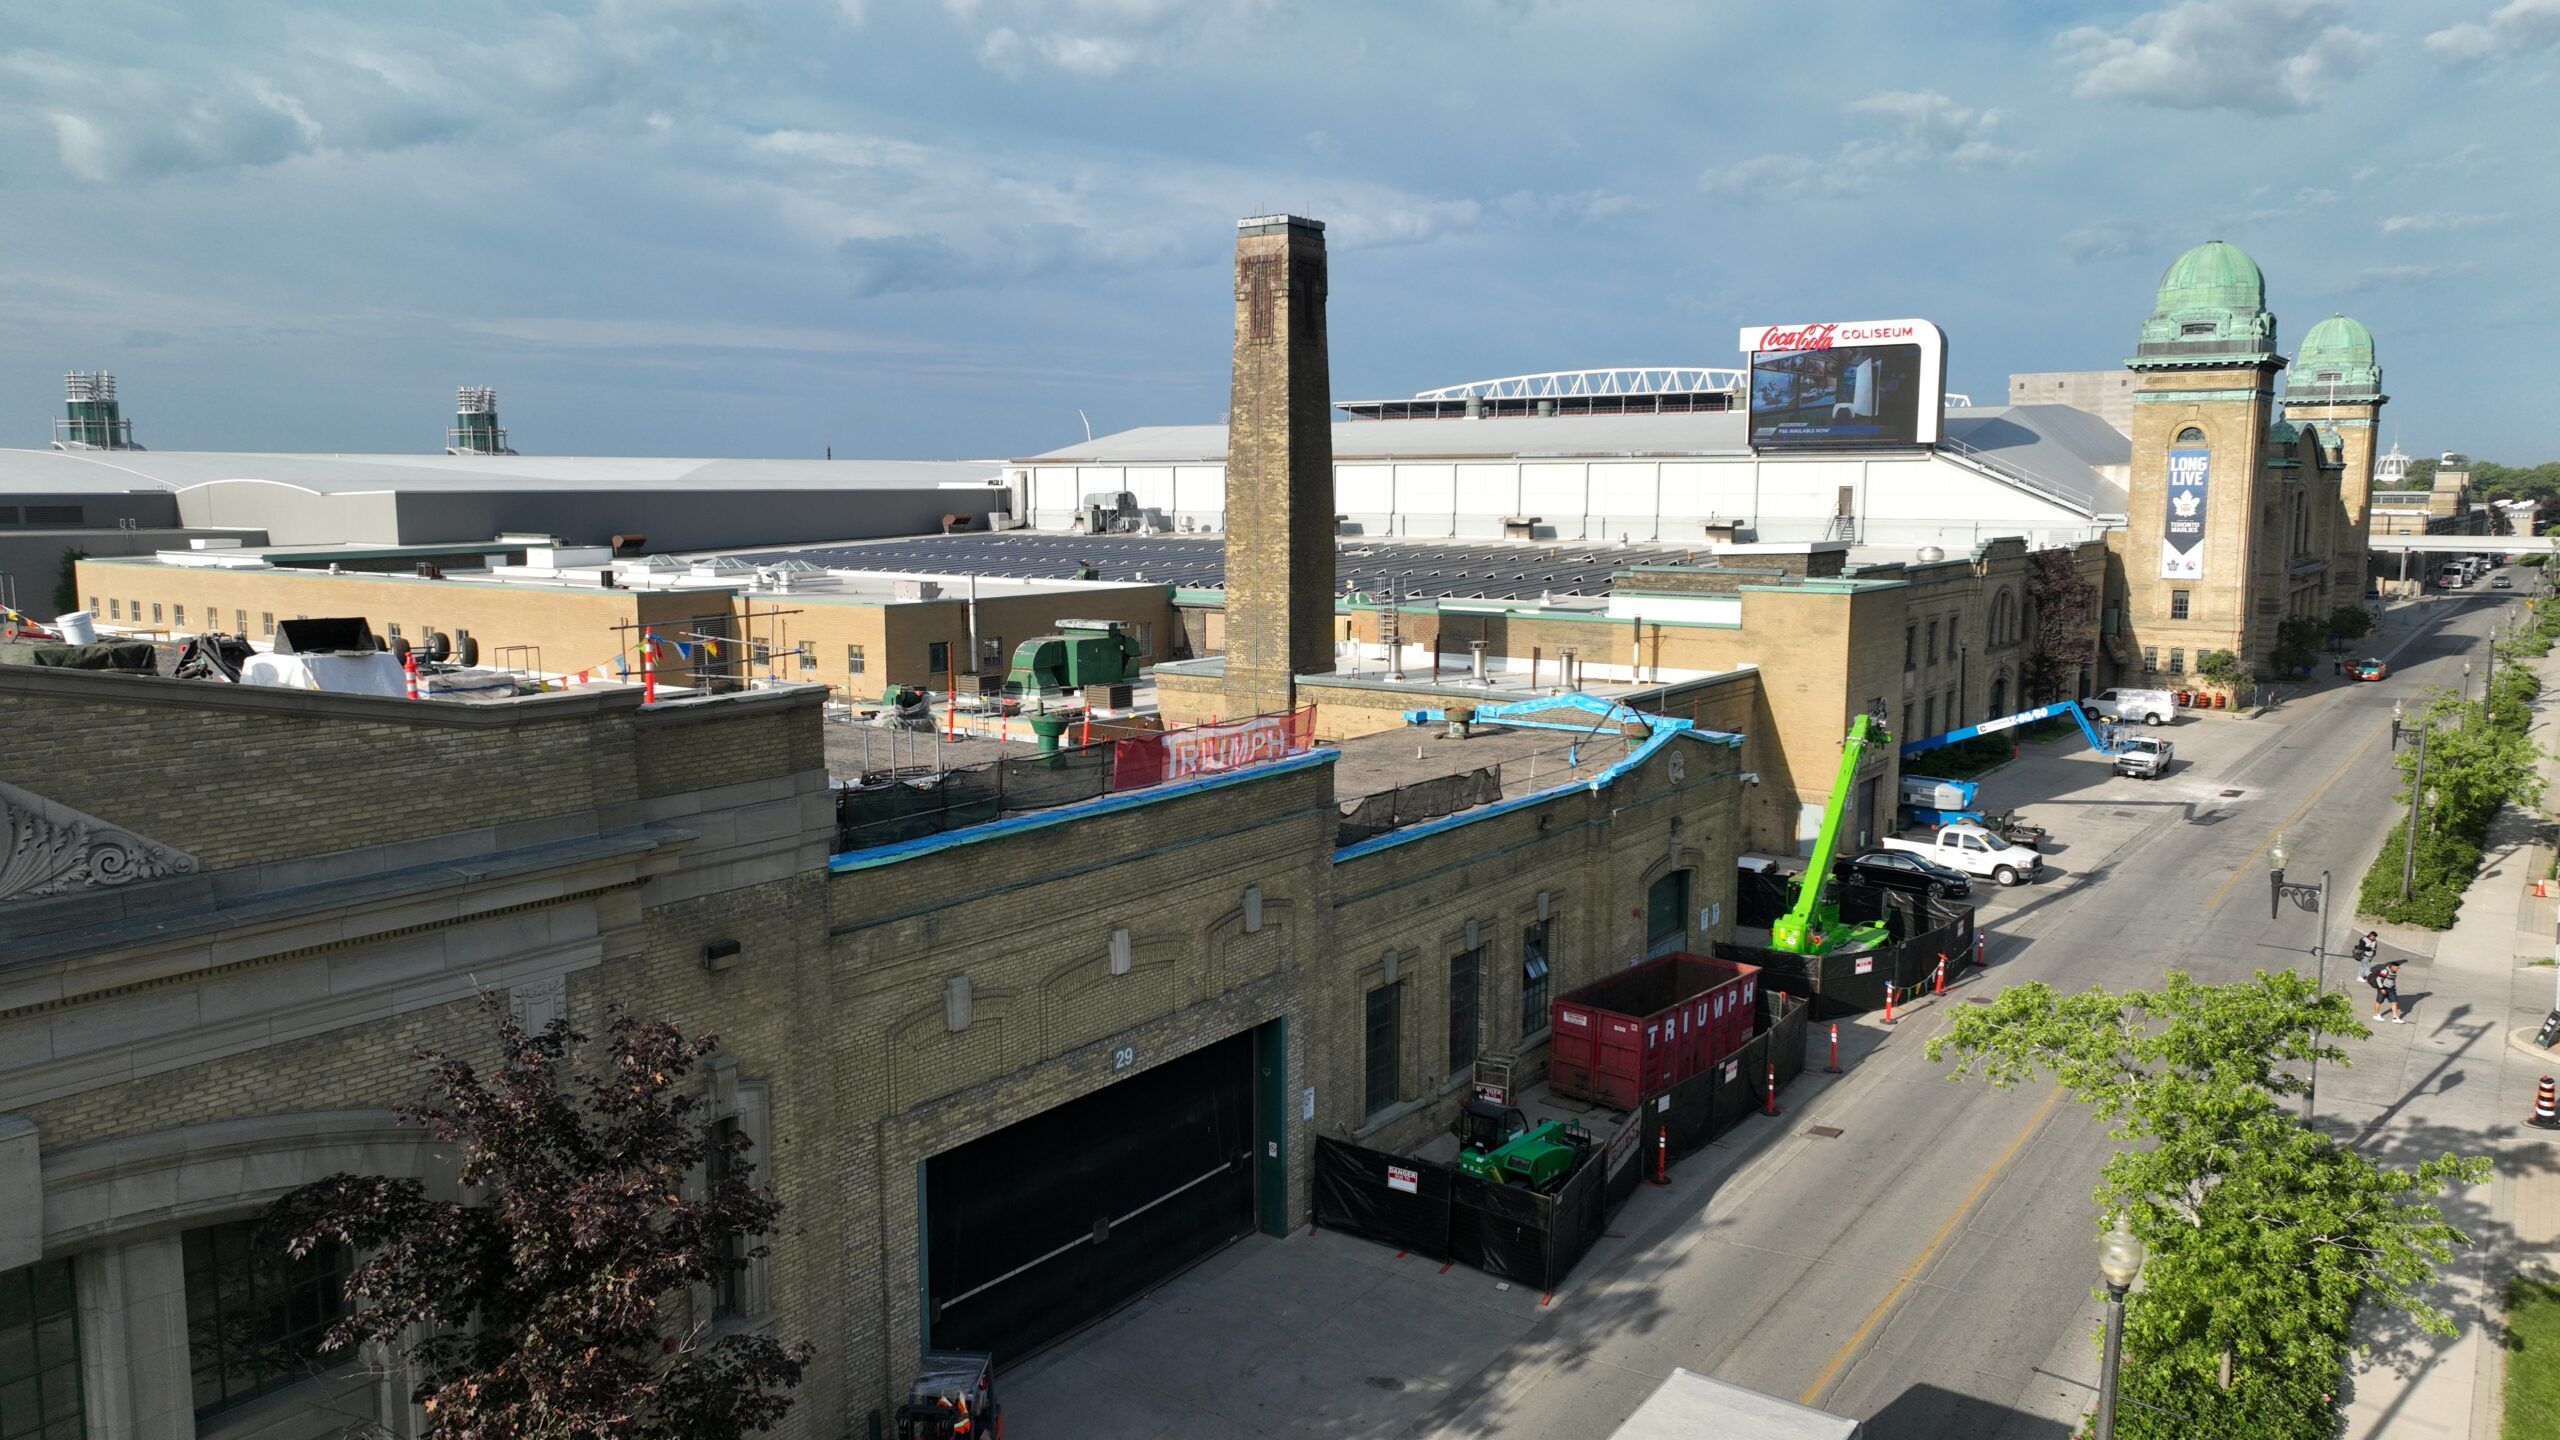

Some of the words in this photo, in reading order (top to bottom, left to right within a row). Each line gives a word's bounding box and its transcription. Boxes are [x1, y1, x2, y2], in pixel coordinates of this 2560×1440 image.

[1760, 323, 1839, 352] Coca-Cola
[1841, 326, 1914, 340] COLISEUM
[2170, 456, 2208, 472] LONG
[2172, 471, 2204, 486] LIVE
[1161, 716, 1286, 779] TRIUMPH
[1648, 981, 1754, 1049] TRIUMPH
[1115, 1047, 1133, 1069] 29
